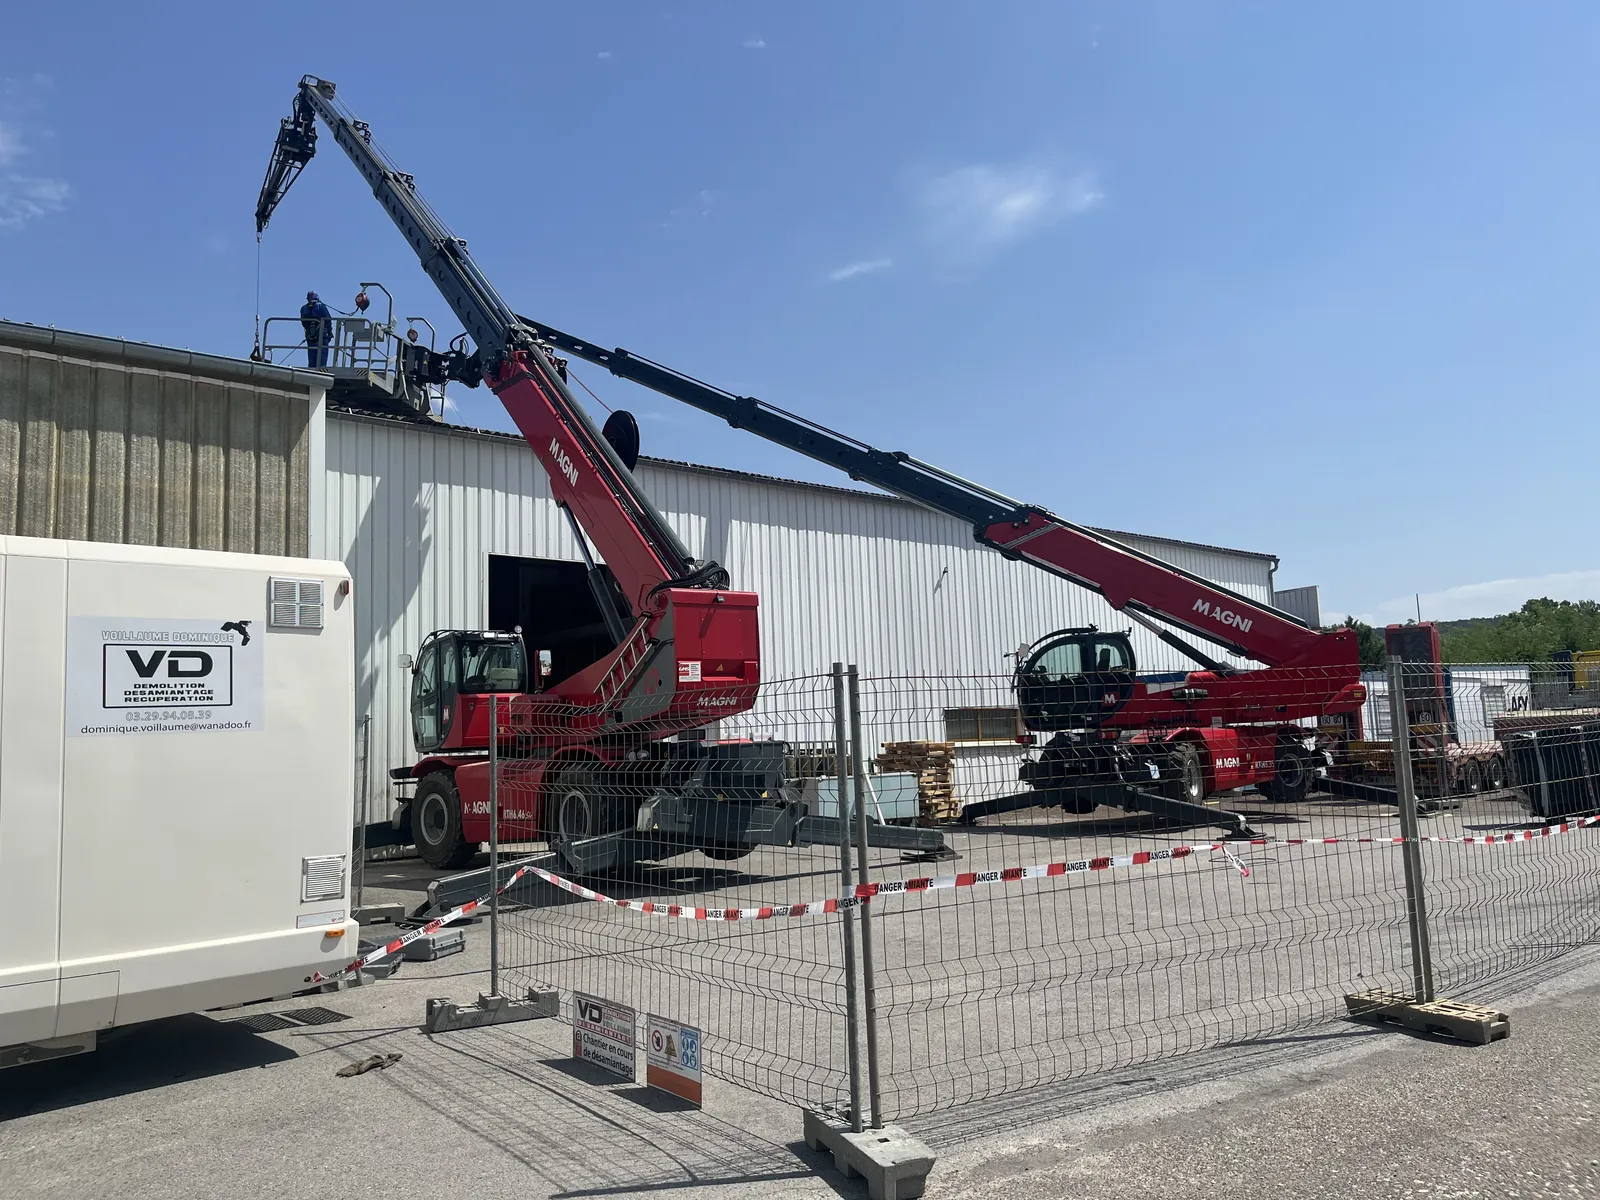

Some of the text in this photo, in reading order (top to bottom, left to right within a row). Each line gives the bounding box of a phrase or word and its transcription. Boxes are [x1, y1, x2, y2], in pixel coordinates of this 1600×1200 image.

[549, 437, 579, 487] MAGNI
[1192, 599, 1253, 633] MAGNI
[101, 630, 235, 643] VOILLAUME DOMINIQUE
[125, 650, 213, 678] VD
[124, 695, 214, 703] RECUPERATION
[696, 696, 738, 707] MAGNI
[125, 710, 212, 722] 03.29.94.08.39
[81, 720, 252, 735] dominique.voillaume@wanadoo.fr
[1216, 757, 1240, 769] MAGNI
[1147, 850, 1170, 861] DANGER
[1062, 858, 1115, 873] DANGER AMIANTE
[972, 868, 1028, 883] DANGER AMIANTE
[874, 879, 934, 894] DANGER AMIANTE
[651, 904, 667, 914] DANGER
[770, 904, 810, 917] DANGER AMIANTE
[834, 897, 859, 910] DANGER
[704, 909, 743, 919] DANGER AMIANTE
[399, 917, 447, 946] DANGER AMIANTE
[344, 956, 369, 974] AMIANTE
[577, 1000, 603, 1024] VD
[583, 1032, 608, 1050] Chantier
[608, 1044, 617, 1054] en
[617, 1047, 633, 1061] cours
[583, 1046, 591, 1059] de
[591, 1049, 633, 1077] désamiantage
